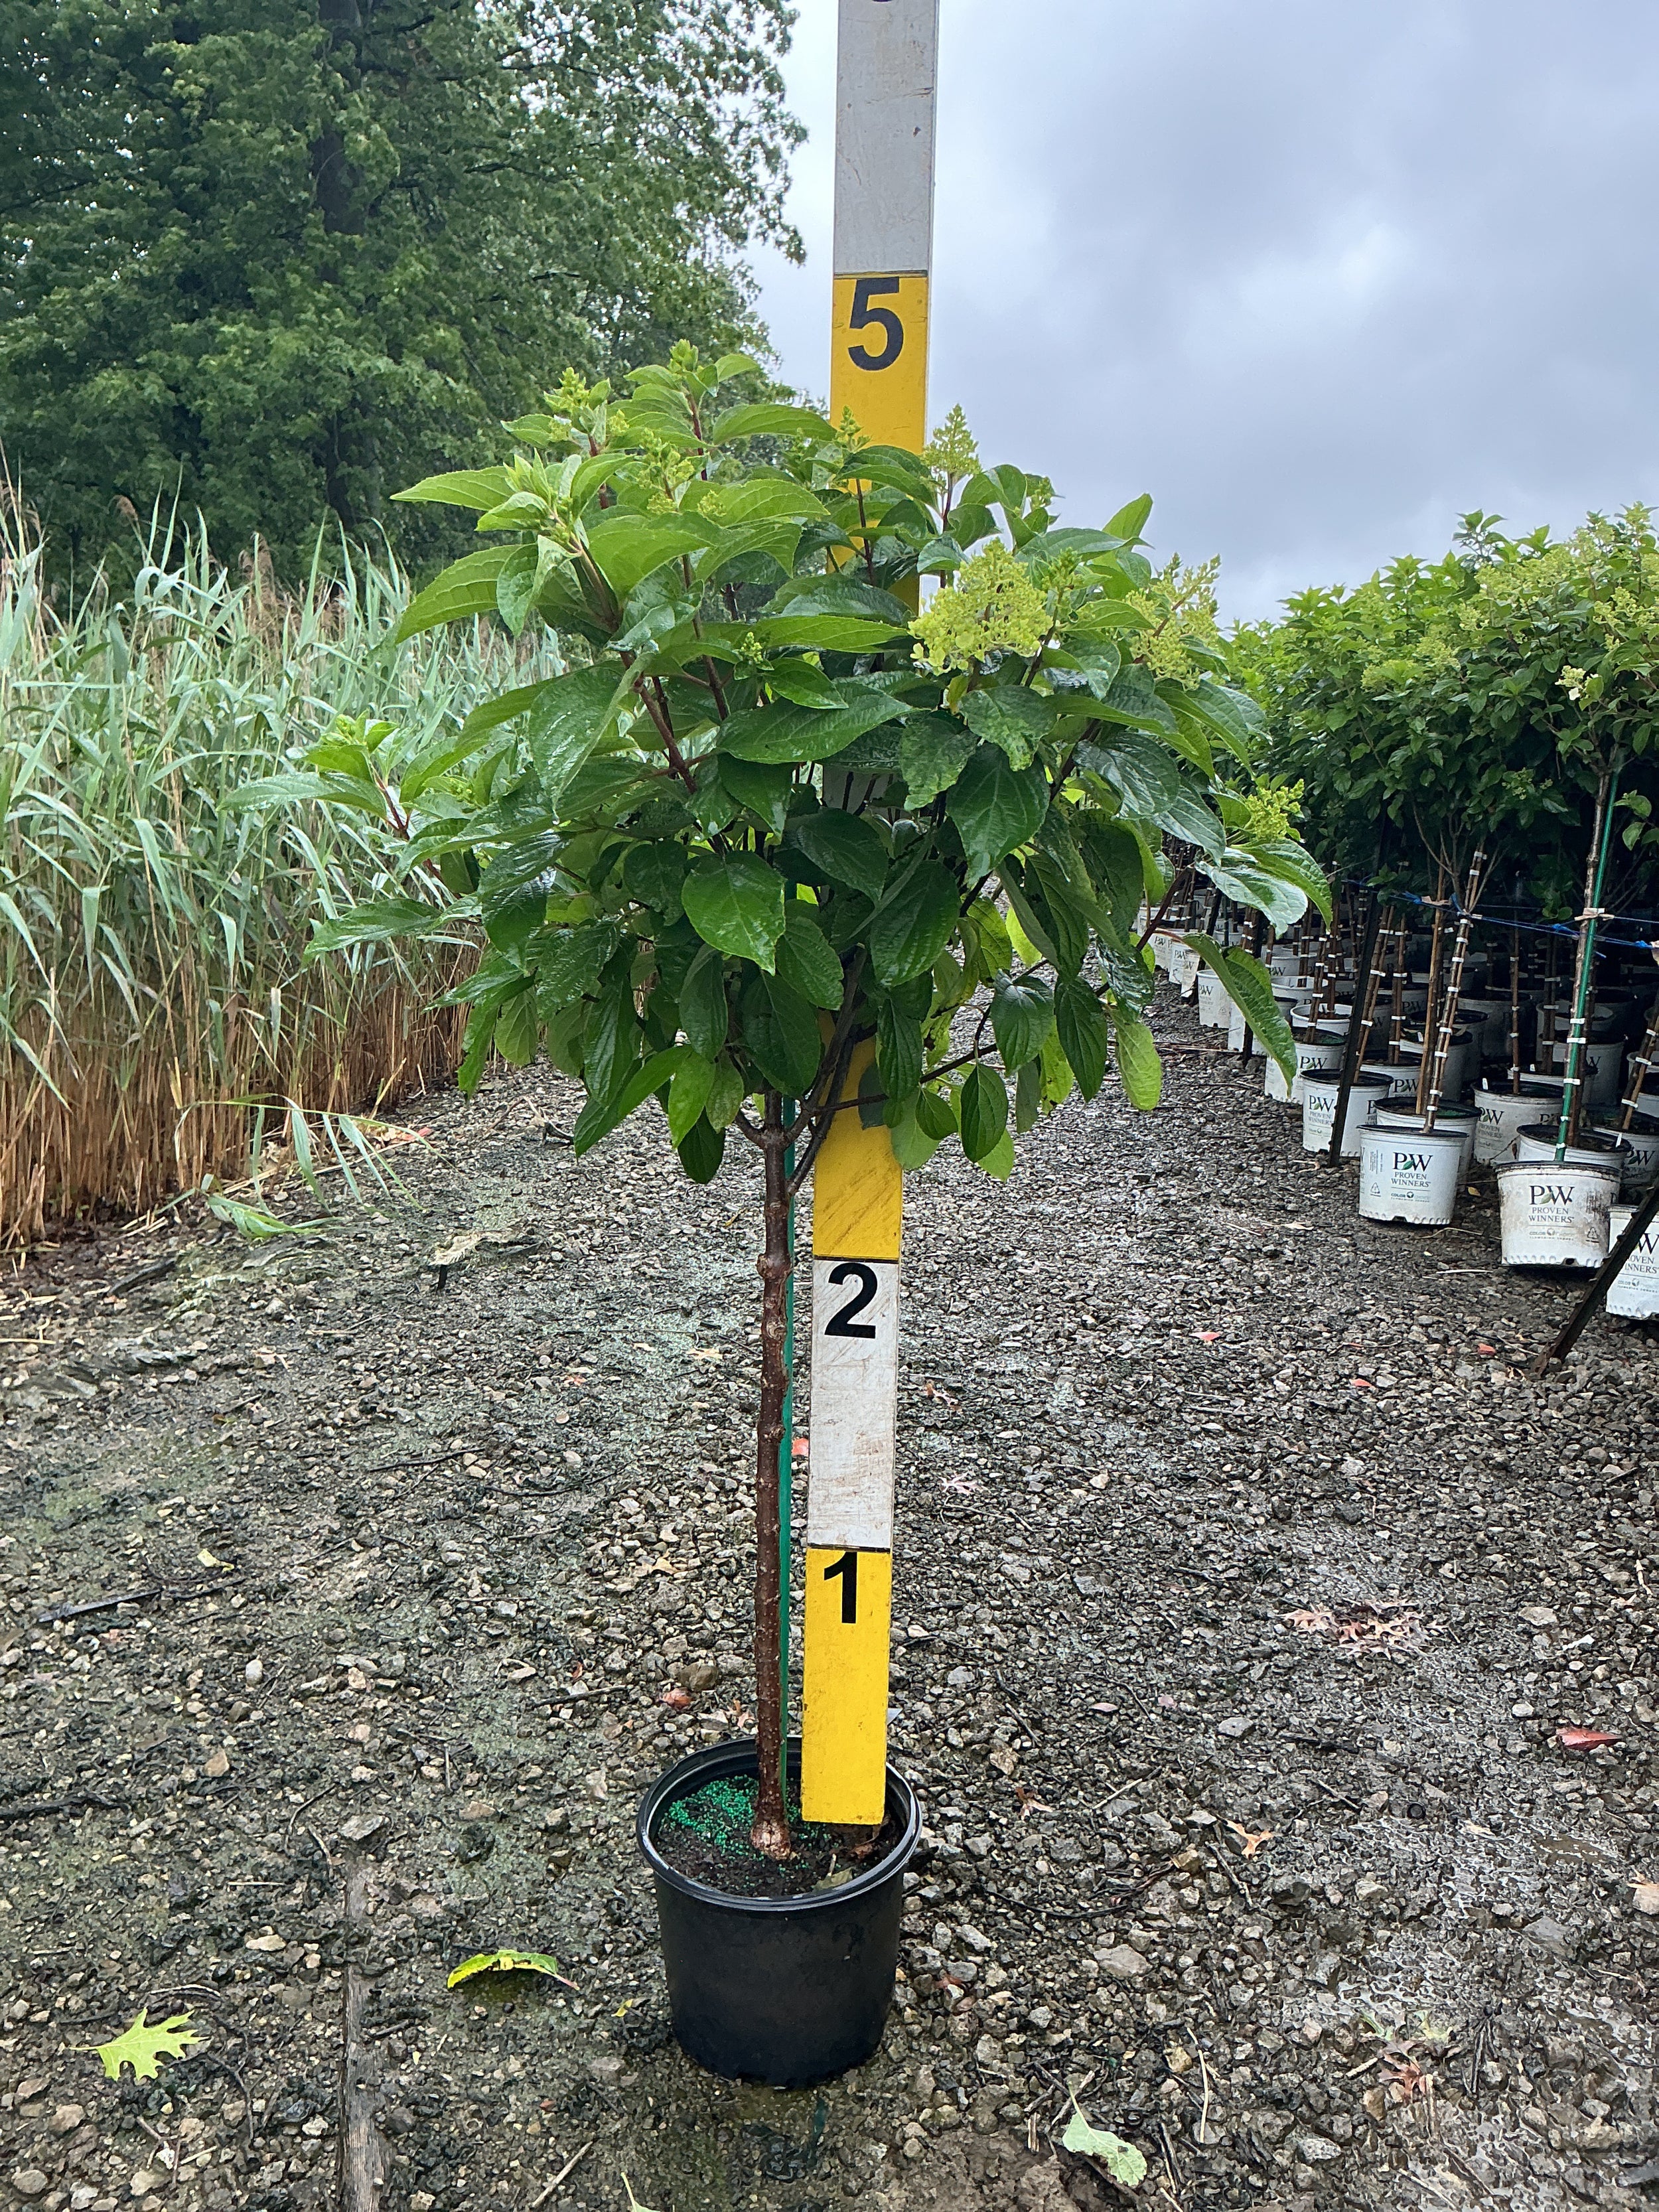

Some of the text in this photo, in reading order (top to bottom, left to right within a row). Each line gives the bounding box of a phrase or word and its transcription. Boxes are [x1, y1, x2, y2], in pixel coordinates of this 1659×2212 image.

[847, 276, 904, 371] 5
[1300, 1056, 1328, 1069] PW
[1393, 1078, 1419, 1092] PW
[1309, 1095, 1334, 1112] PW
[1393, 1152, 1433, 1172] PW
[1391, 1178, 1431, 1188] WINNERS
[1529, 1185, 1575, 1205] PW
[1528, 1215, 1574, 1224] WINNERS
[1638, 1232, 1659, 1254] W
[1629, 1254, 1655, 1264] OVEN
[1624, 1264, 1658, 1274] INNERS
[824, 1262, 878, 1339] 2
[824, 1551, 859, 1625] 1
